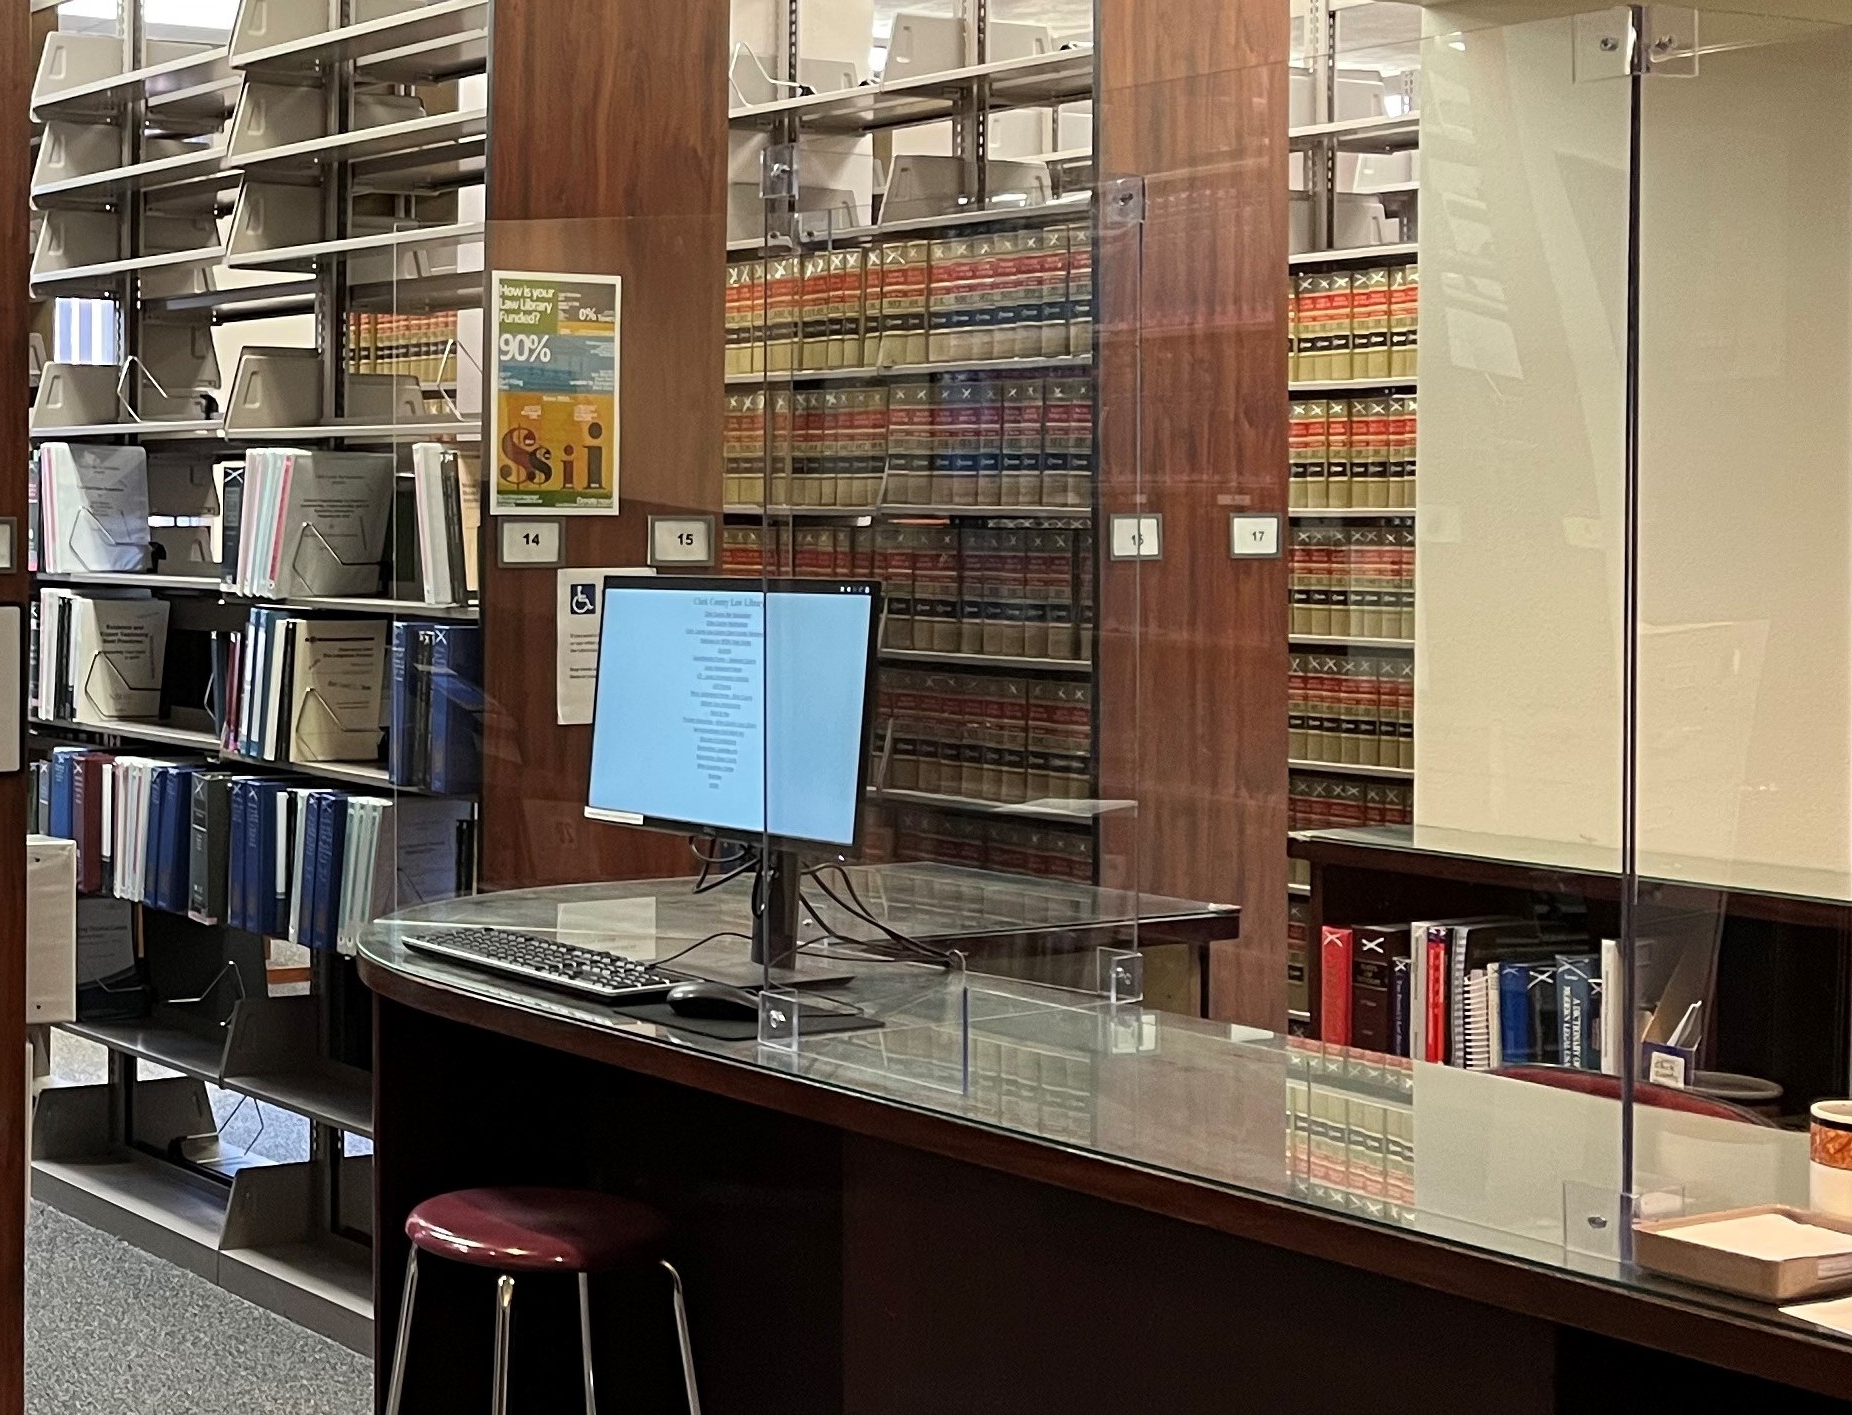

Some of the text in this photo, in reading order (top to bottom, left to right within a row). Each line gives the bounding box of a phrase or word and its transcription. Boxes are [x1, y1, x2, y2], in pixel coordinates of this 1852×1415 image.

[500, 284, 554, 300] How is your
[500, 298, 519, 309] Law
[520, 298, 552, 314] Library
[500, 312, 540, 324] Funded?
[579, 308, 596, 320] 0%
[500, 334, 551, 362] 90%
[523, 534, 540, 546] 14
[677, 534, 694, 545] 15
[1252, 531, 1264, 542] 17
